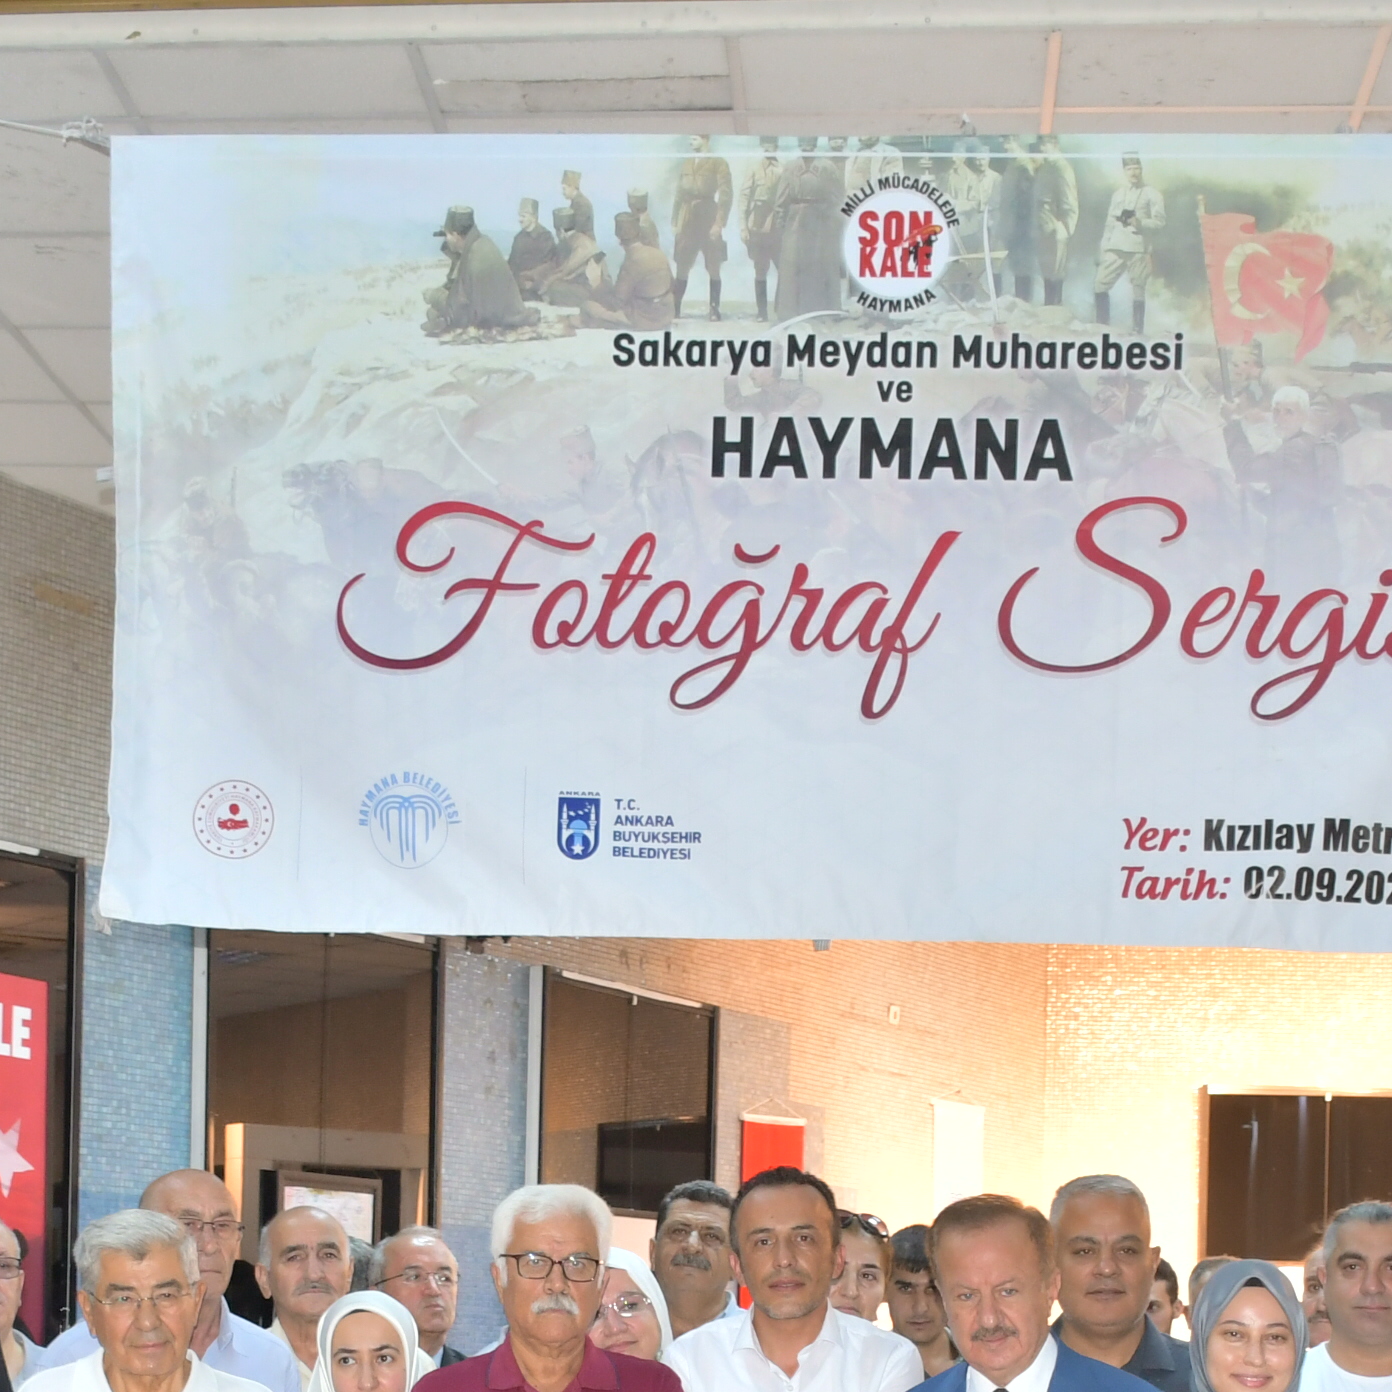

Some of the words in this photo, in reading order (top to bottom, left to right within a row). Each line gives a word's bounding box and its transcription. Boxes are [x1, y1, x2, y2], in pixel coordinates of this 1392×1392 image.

[877, 172, 960, 229] MÜCADELEDE
[858, 210, 934, 248] SON
[859, 246, 934, 278] KALE
[856, 289, 937, 313] HAYMANA
[612, 332, 771, 375] Sakarya
[786, 333, 938, 376] Meydan
[952, 333, 1184, 371] Muharebesi
[876, 380, 913, 402] ve
[710, 416, 1074, 482] HAYMANA
[336, 501, 964, 718] Fotoğraf
[358, 773, 398, 827] HAYMANA
[613, 799, 641, 811] T.C.
[613, 815, 675, 828] ANKARA
[1121, 817, 1190, 853] Yer:
[1204, 818, 1315, 854] Kızılay
[1120, 865, 1230, 901] Tarih:
